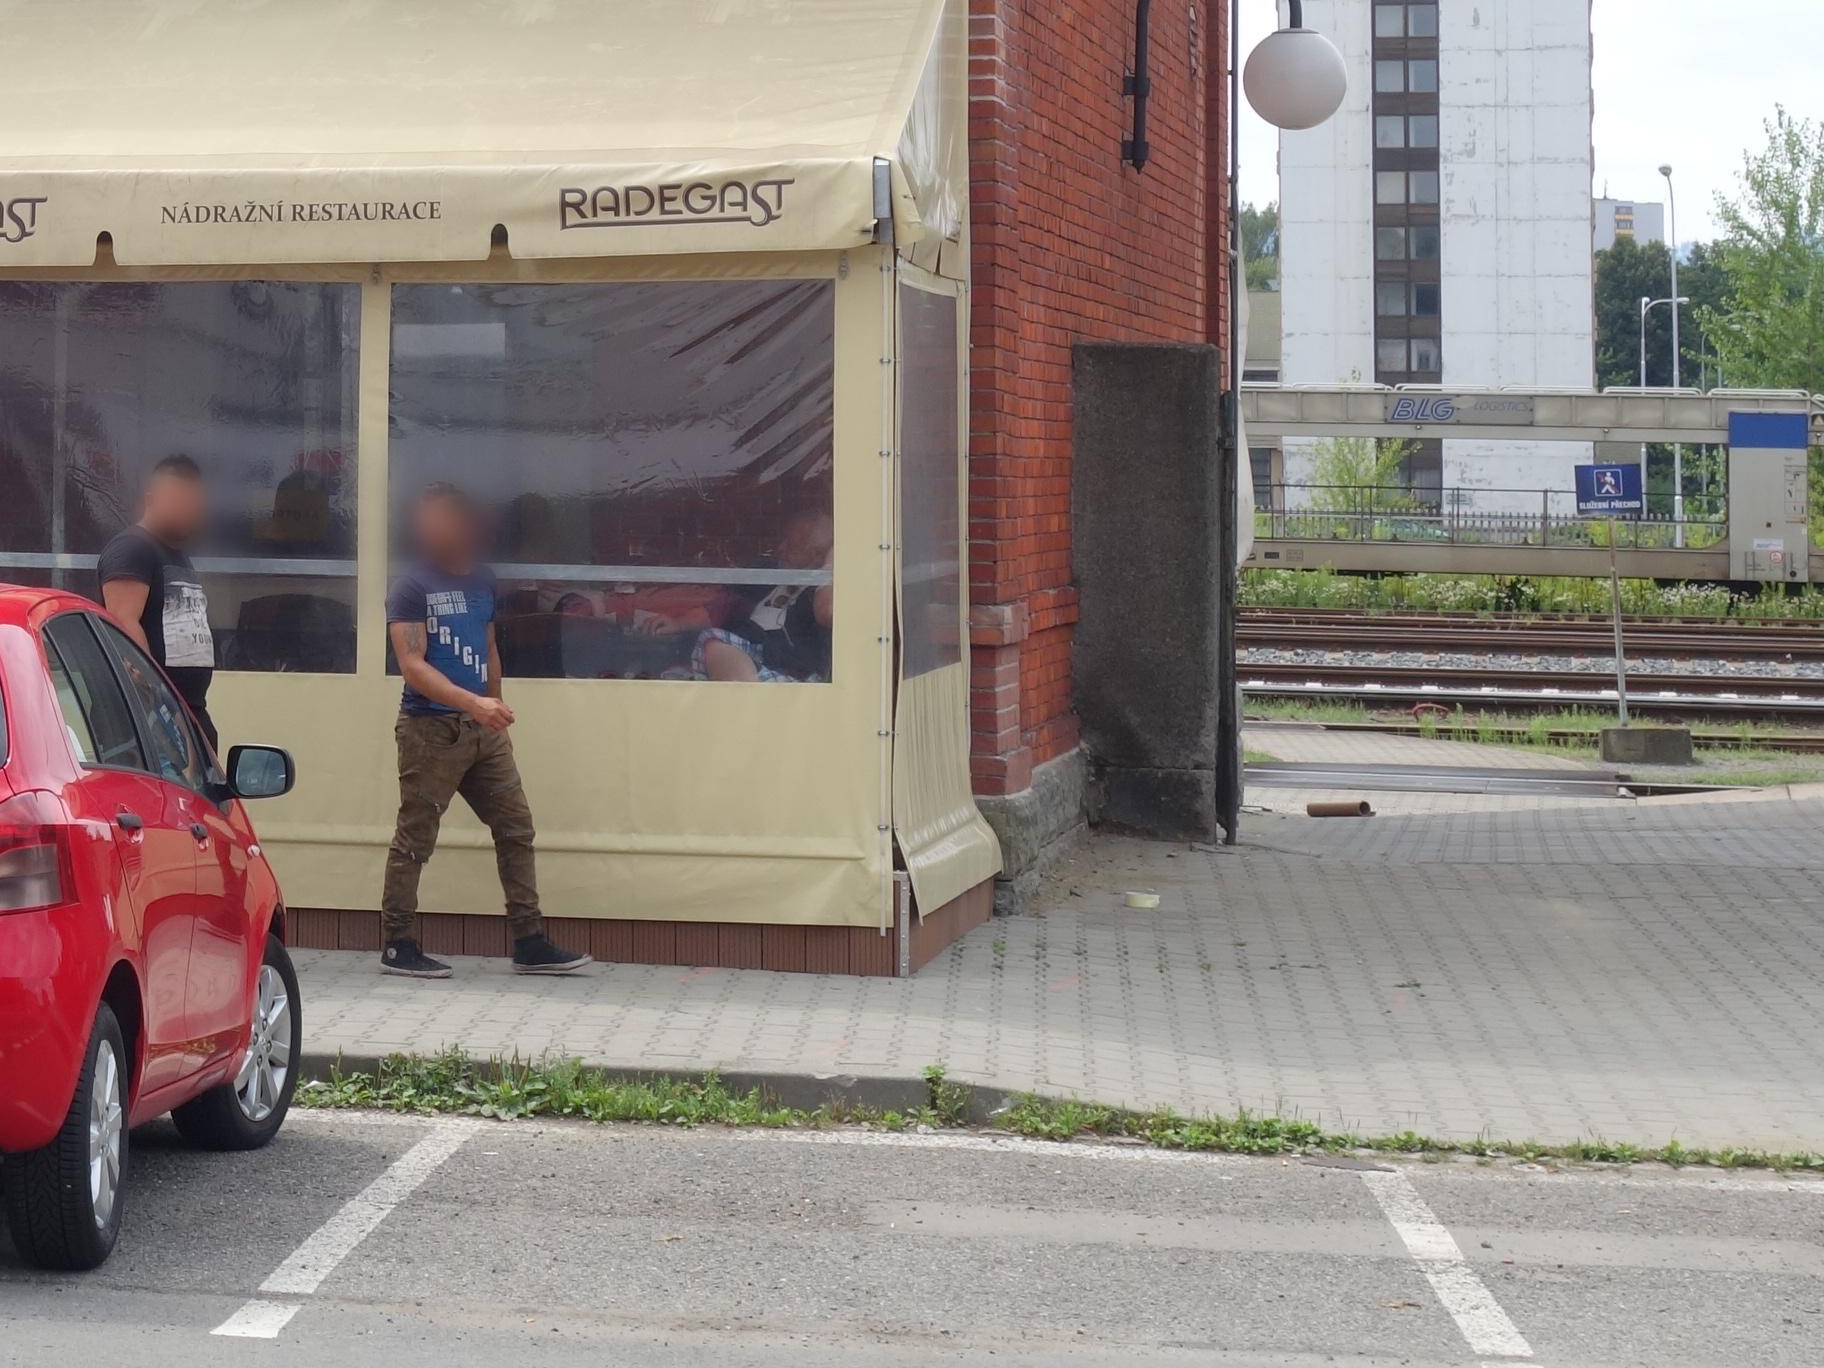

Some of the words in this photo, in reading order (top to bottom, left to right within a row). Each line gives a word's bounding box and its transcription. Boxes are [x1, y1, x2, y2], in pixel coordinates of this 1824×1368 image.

[160, 197, 285, 225] NÁDRAŽNÍ
[290, 199, 443, 224] RESTAURACE
[559, 177, 796, 230] RADEGAST
[1391, 398, 1455, 421] BLG
[1473, 399, 1529, 413] LOGISTICS
